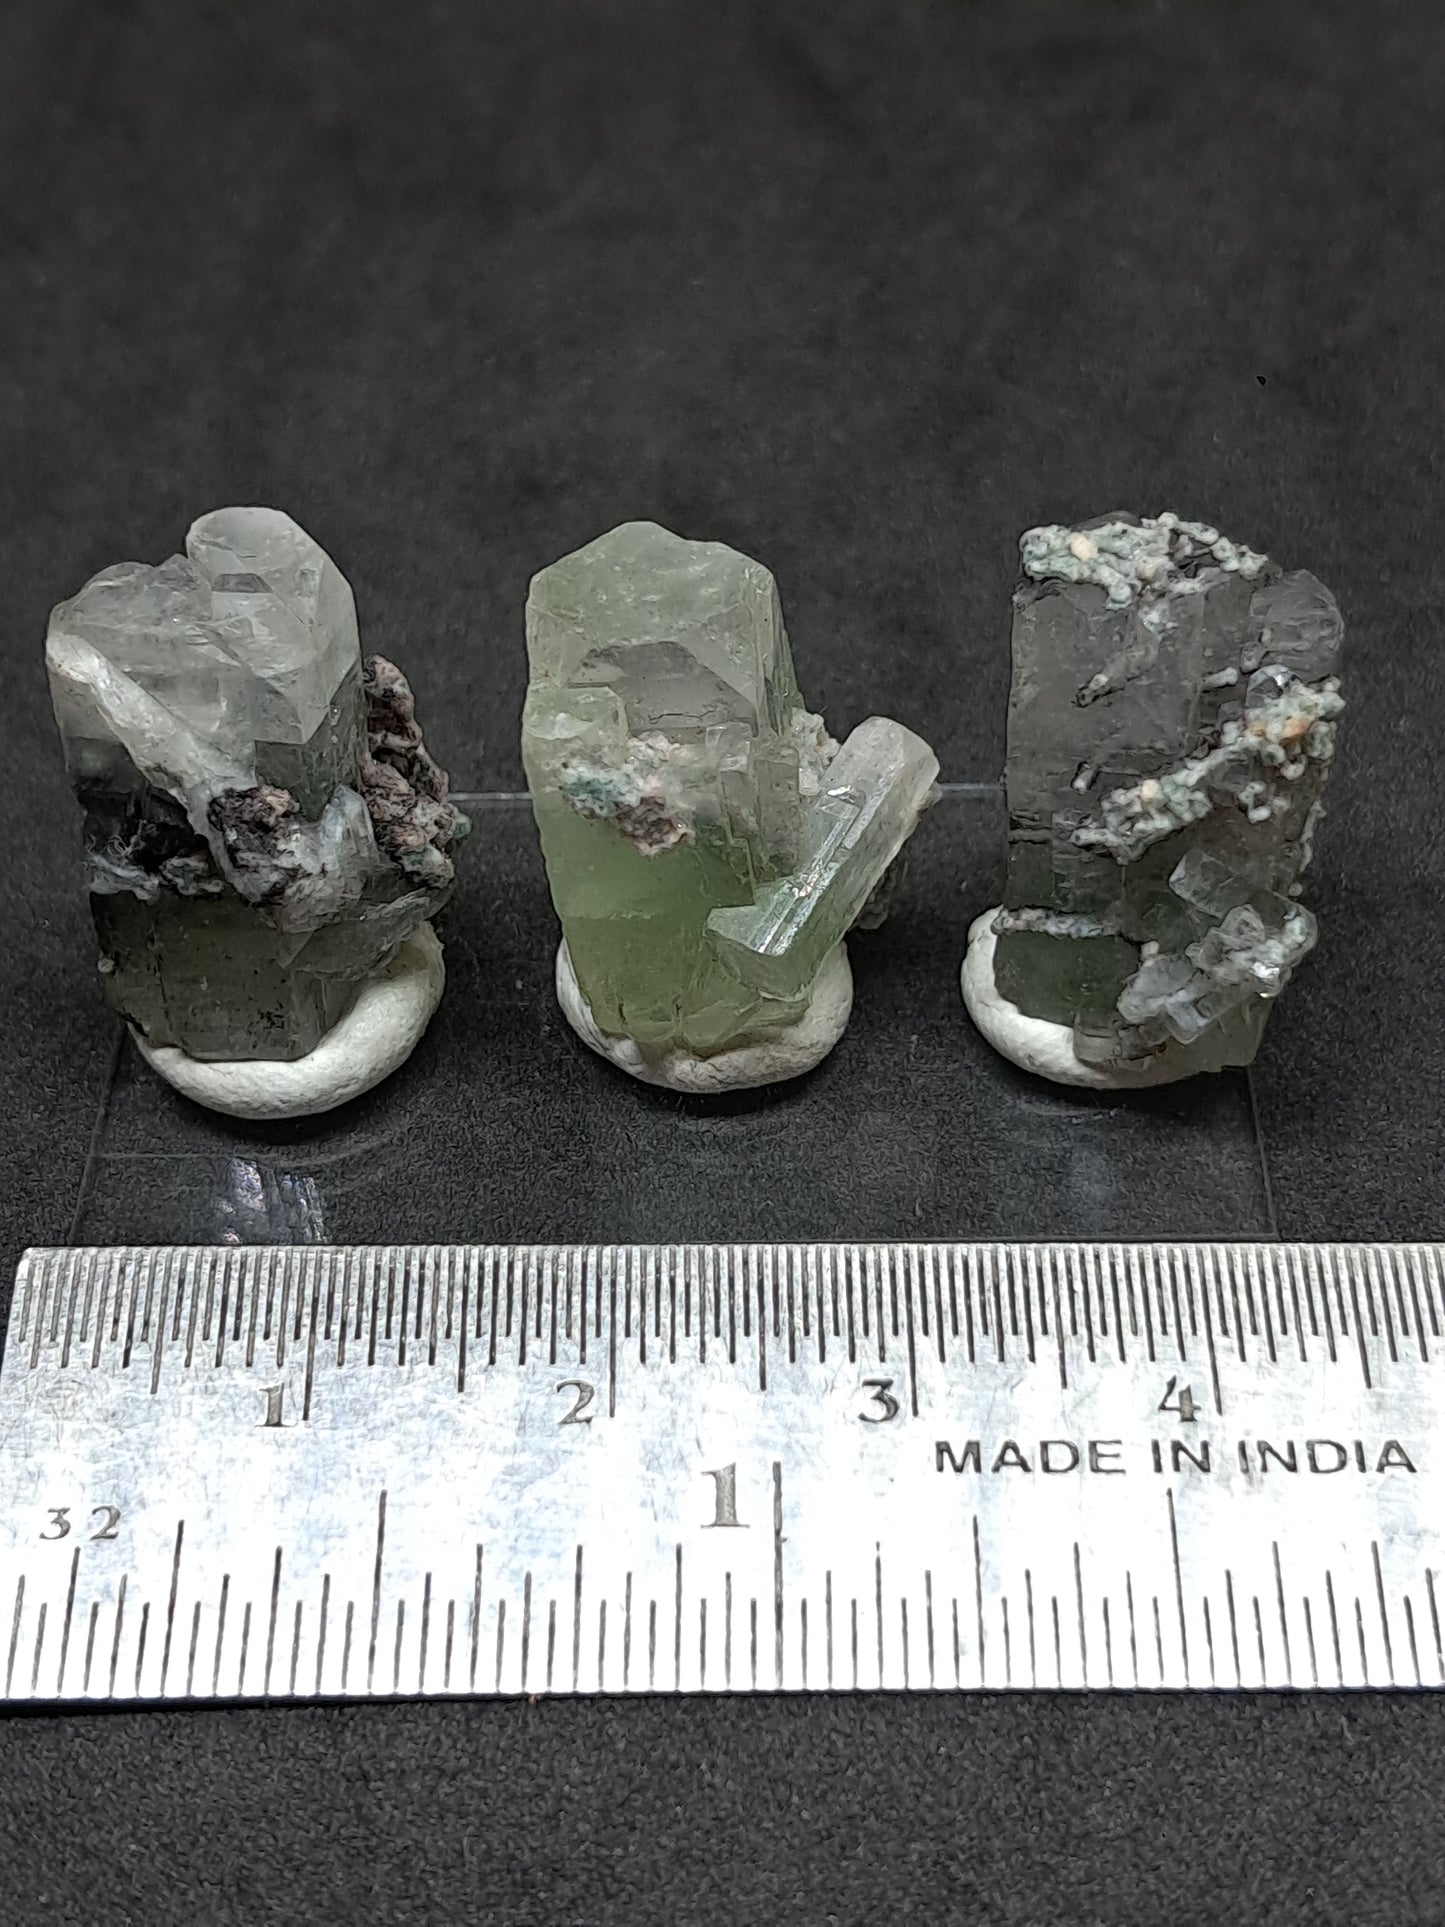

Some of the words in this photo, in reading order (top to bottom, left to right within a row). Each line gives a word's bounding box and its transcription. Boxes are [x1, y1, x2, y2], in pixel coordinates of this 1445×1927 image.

[255, 1382, 296, 1428] 1
[555, 1379, 596, 1425] 2
[857, 1377, 900, 1424] 3
[1157, 1375, 1201, 1423] 4
[934, 1439, 1126, 1475] MADE
[1151, 1439, 1212, 1475] IN
[1237, 1439, 1418, 1475] INDIA
[700, 1462, 750, 1529] 1
